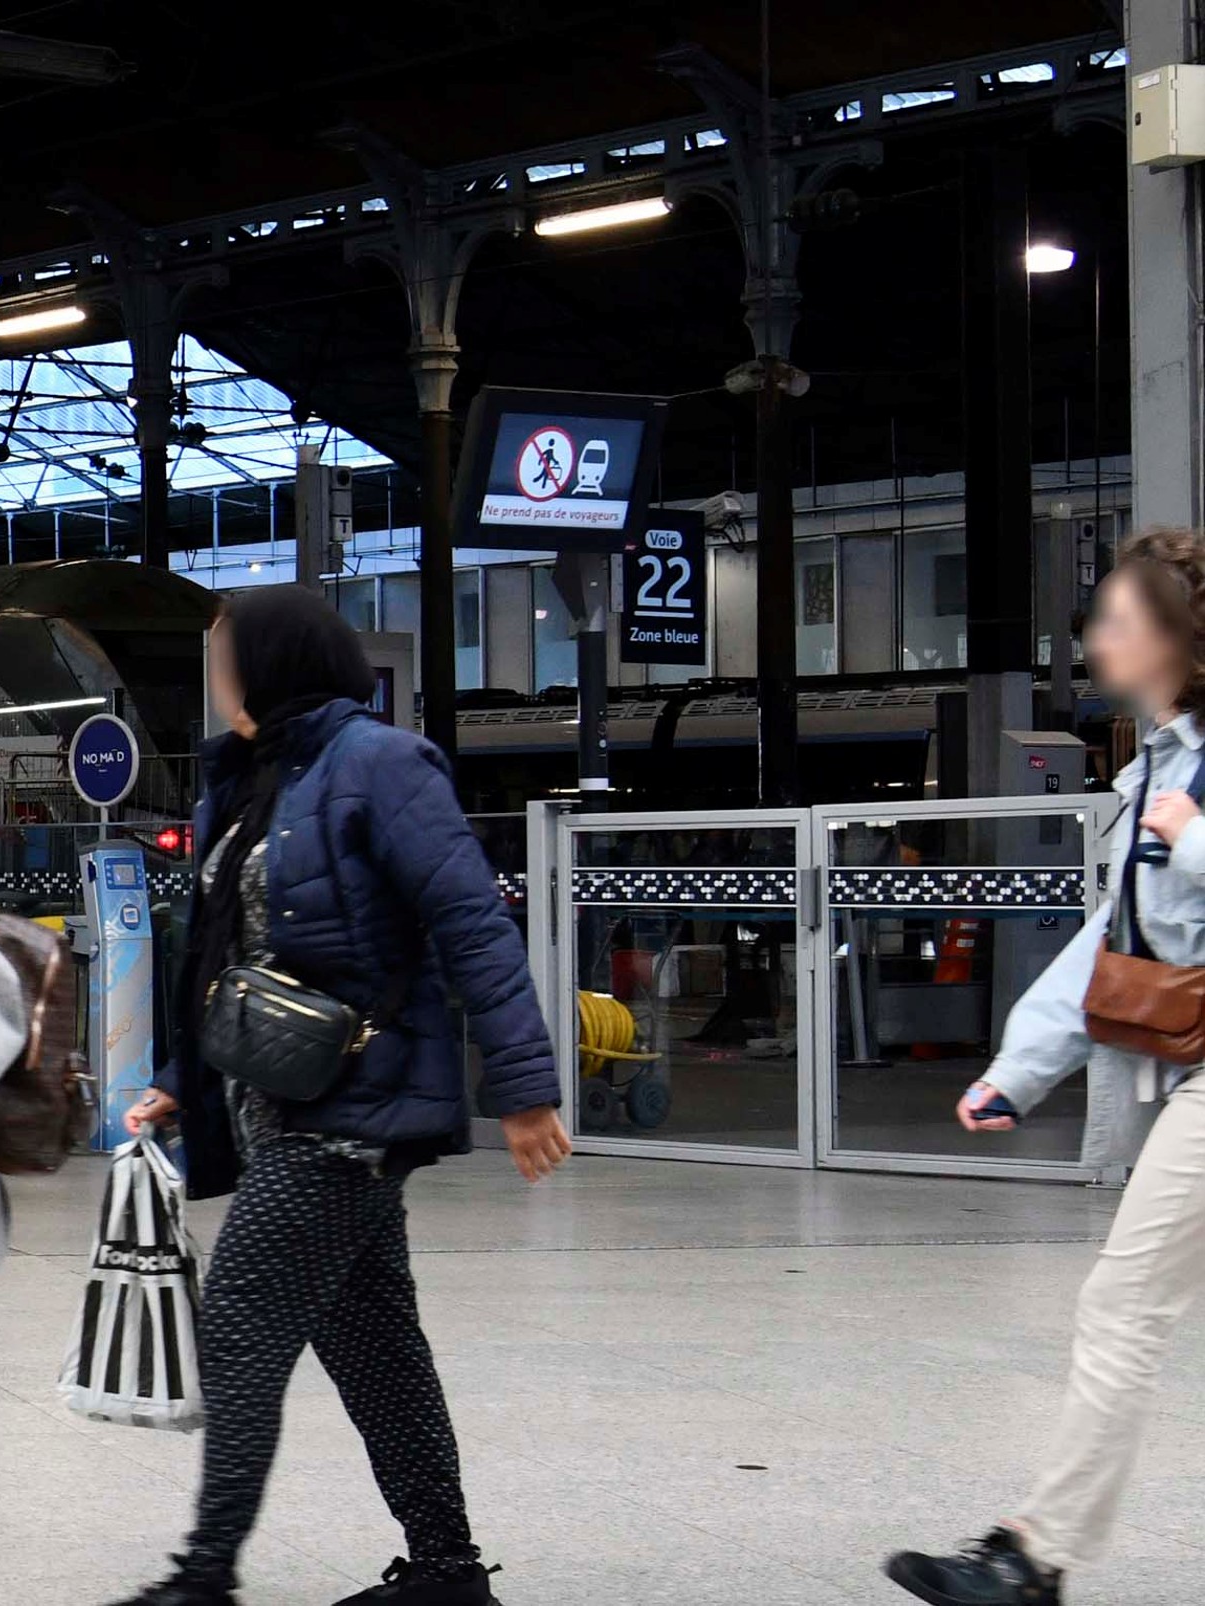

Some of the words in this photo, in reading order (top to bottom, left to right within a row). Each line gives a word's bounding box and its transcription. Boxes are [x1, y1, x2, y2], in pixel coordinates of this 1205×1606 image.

[484, 505, 499, 516] Ne
[501, 506, 531, 518] prend
[534, 508, 552, 519] pas
[554, 508, 566, 519] de
[569, 511, 620, 523] voyageurs
[339, 519, 350, 533] T
[649, 532, 677, 547] Voie
[637, 554, 692, 608] 22
[629, 627, 662, 642] Zone
[664, 628, 699, 644] bleue
[1048, 777, 1058, 789] 19
